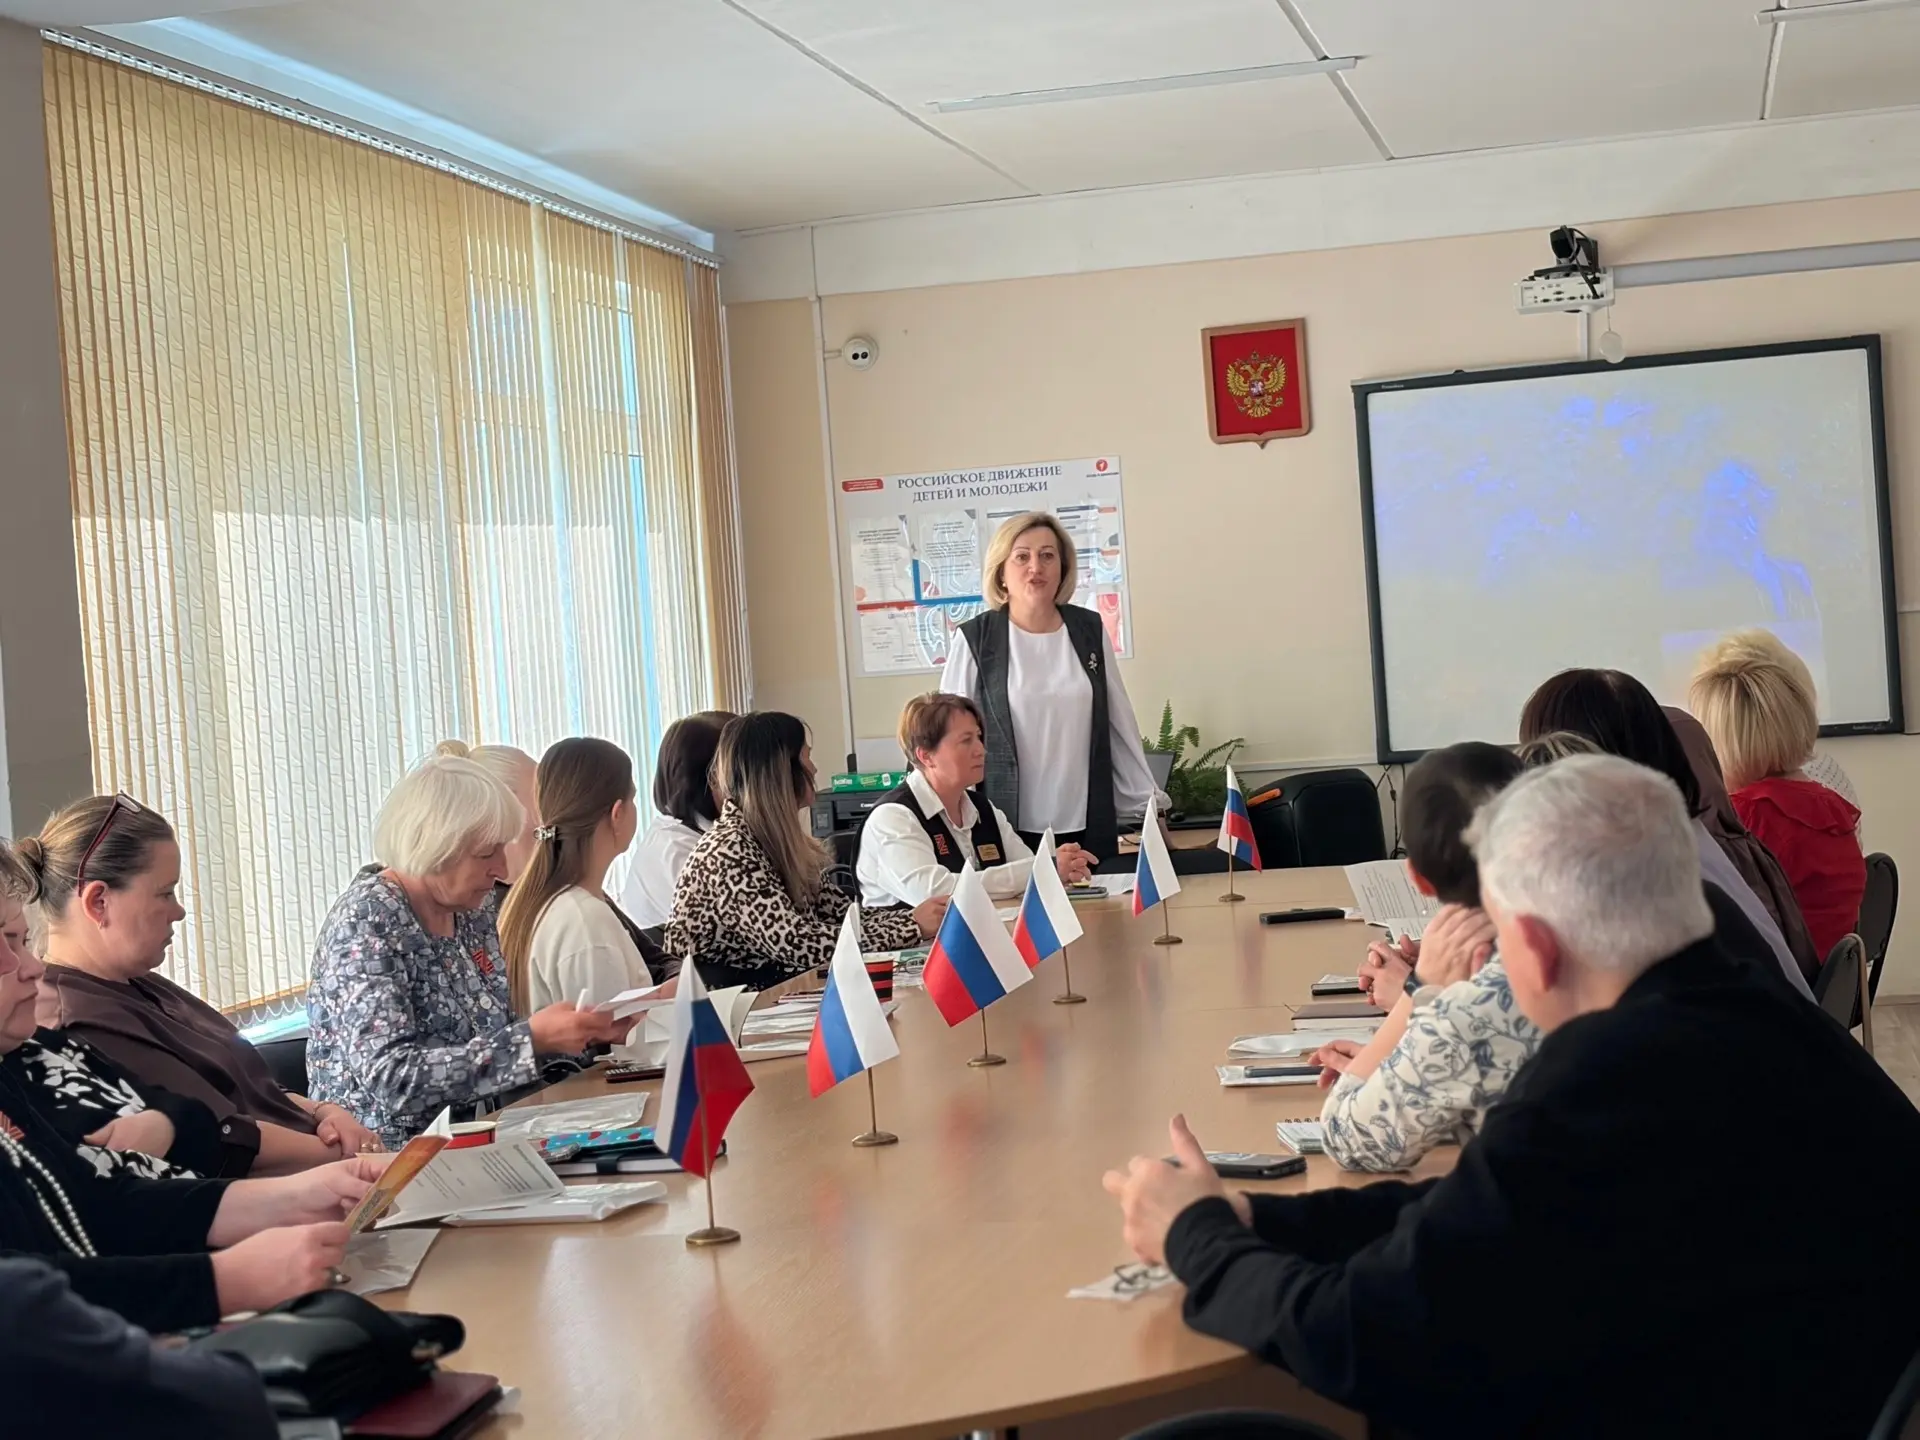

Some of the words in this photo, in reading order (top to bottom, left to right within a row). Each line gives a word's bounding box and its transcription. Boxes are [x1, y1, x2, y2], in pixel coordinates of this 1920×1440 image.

[898, 472, 986, 489] РОССИЙСКОЕ
[988, 465, 1062, 482] ДВИЖЕНИЕ
[912, 487, 953, 503] ДЕТЕЙ
[957, 488, 966, 498] И
[969, 481, 1048, 497] МОЛОДЕЖИ
